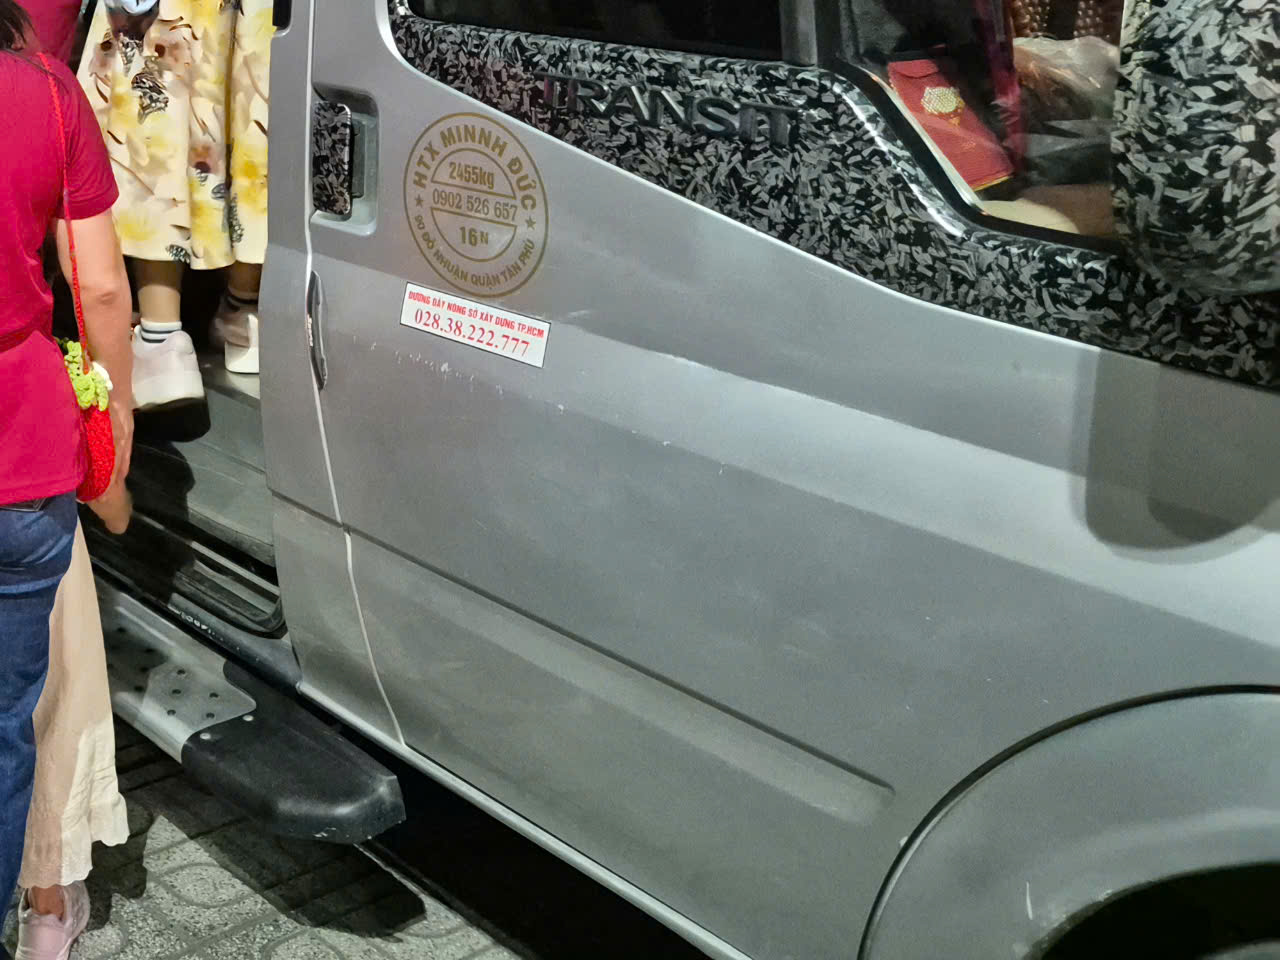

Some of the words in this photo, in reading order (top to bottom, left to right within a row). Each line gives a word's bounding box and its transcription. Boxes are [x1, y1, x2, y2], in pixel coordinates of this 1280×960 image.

[534, 71, 800, 145] TRANSIT
[413, 141, 440, 189] HTX
[449, 162, 495, 190] 2455kg
[432, 188, 462, 209] 0902
[466, 195, 490, 216] 526
[494, 201, 518, 221] 657
[415, 308, 530, 357] 028.38.222.777
[517, 322, 545, 338] TP.HCM
